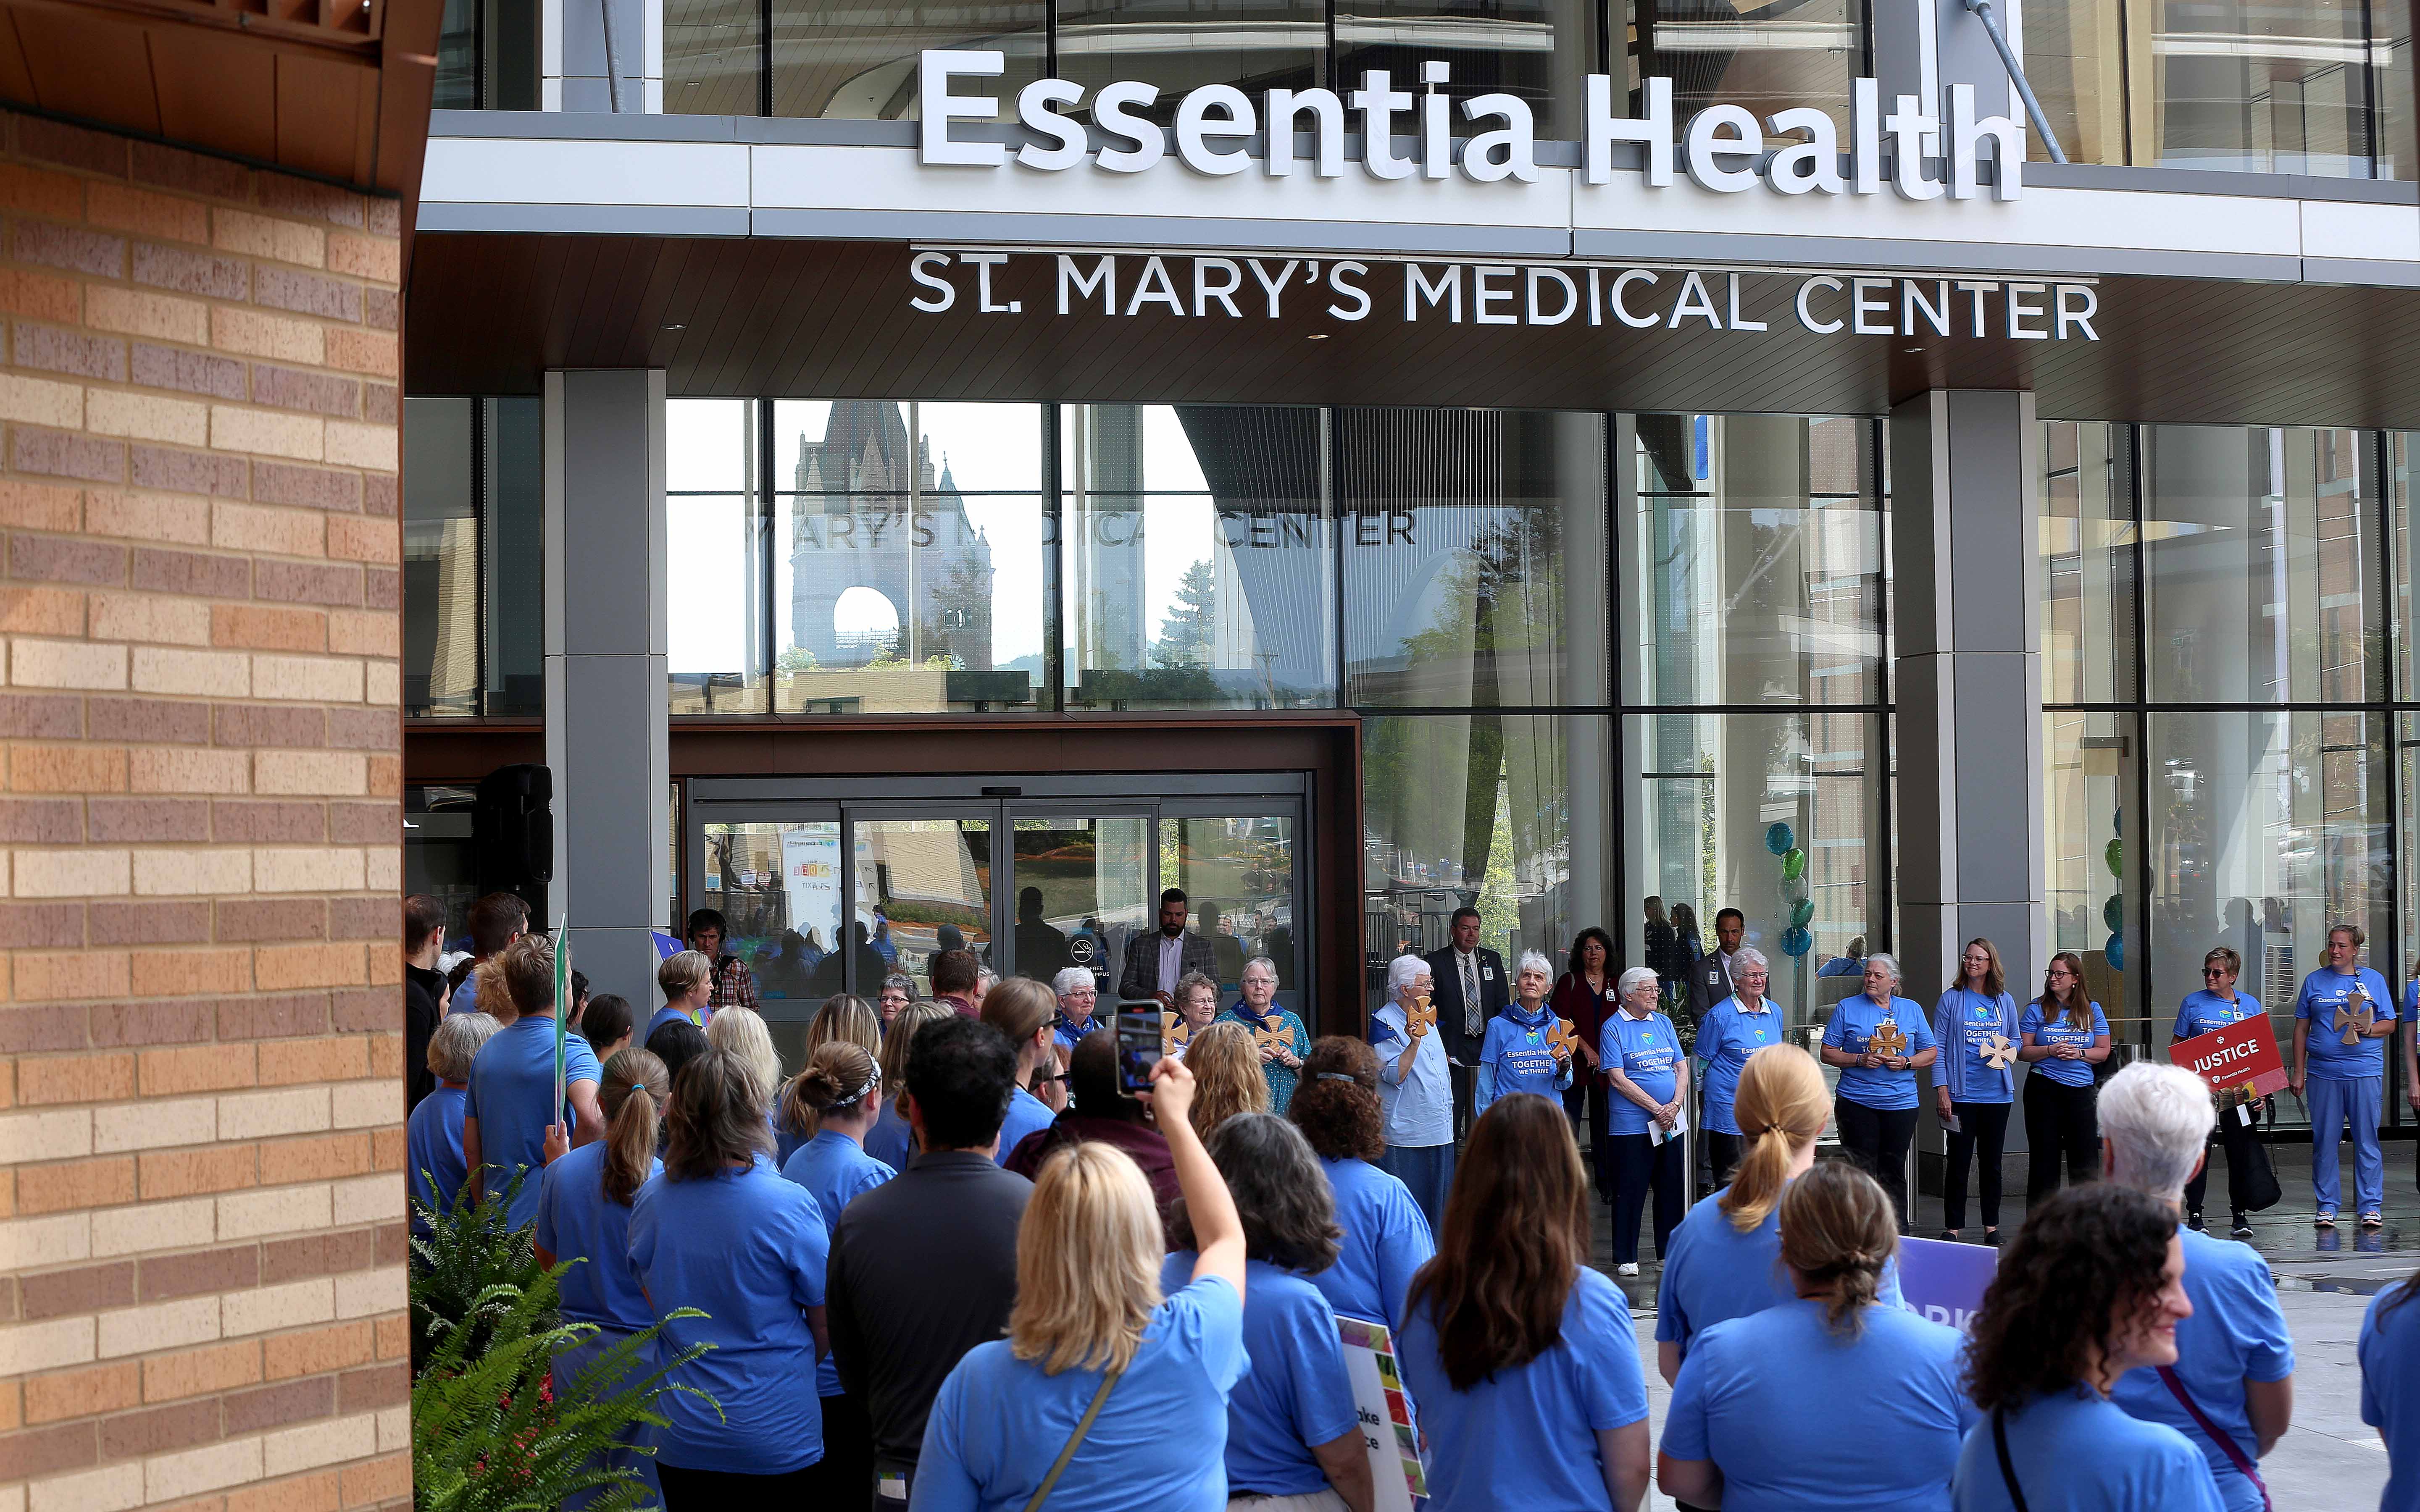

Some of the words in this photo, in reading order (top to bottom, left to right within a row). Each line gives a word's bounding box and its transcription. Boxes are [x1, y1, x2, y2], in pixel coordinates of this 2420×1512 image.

[918, 50, 1539, 185] Essentia
[1581, 74, 2022, 202] Health
[909, 252, 1022, 313] ST.
[1055, 255, 1371, 322] MARY’S
[1404, 262, 1768, 333] MEDICAL
[1795, 276, 2100, 341] CENTER
[1507, 1049, 1536, 1058] Essentia
[1630, 1049, 1656, 1059] Essentia
[2194, 1039, 2260, 1074] JUSTICE
[1512, 1059, 1553, 1068] TOGETHER
[2221, 1071, 2238, 1080] Essentia
